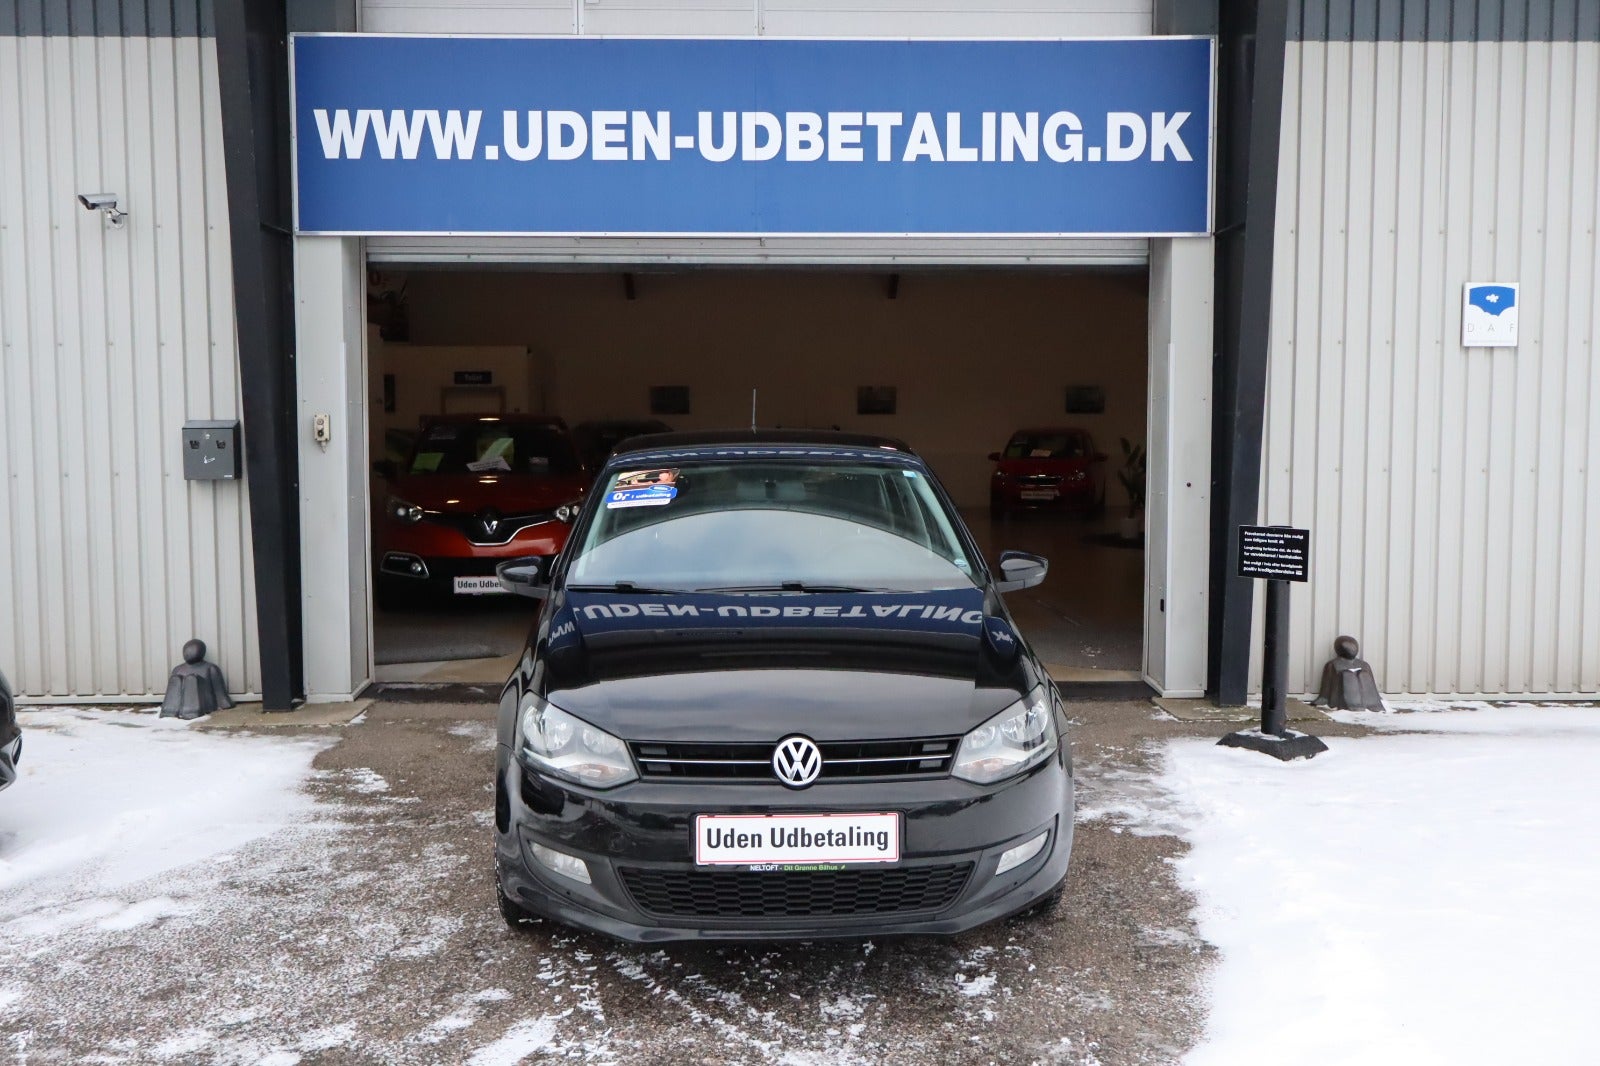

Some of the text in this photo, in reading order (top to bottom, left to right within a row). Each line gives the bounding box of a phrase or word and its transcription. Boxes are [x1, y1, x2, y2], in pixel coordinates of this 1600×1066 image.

[313, 109, 1193, 163] WWW.UDEN-UDBETALING.DK
[457, 580, 478, 588] Uden
[706, 826, 889, 851] Uden Udbetaling
